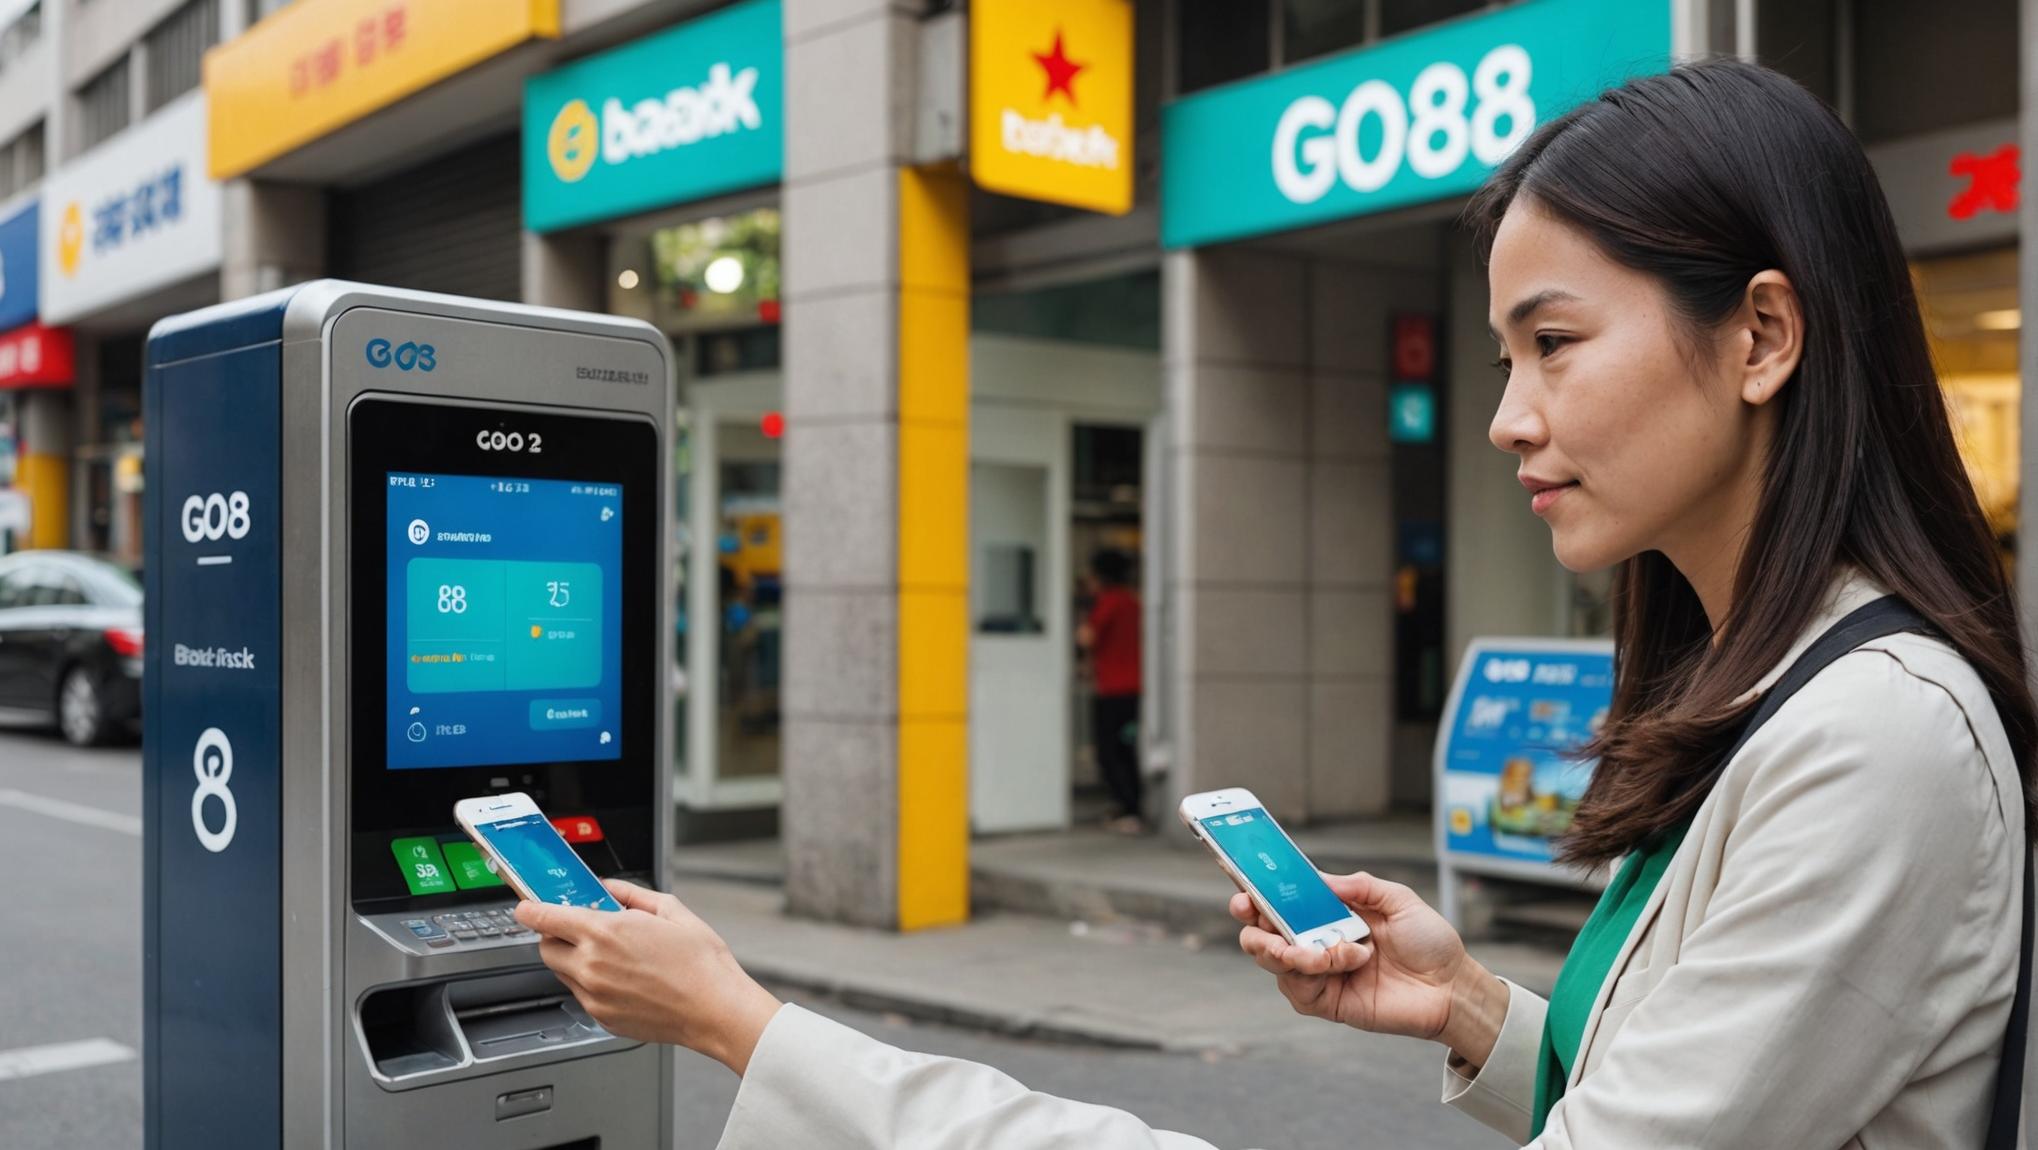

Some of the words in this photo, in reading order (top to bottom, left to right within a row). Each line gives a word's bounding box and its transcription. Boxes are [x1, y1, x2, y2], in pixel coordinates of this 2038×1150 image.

[1271, 43, 1536, 205] GO88
[181, 491, 251, 543] GO8
[437, 584, 467, 614] 88
